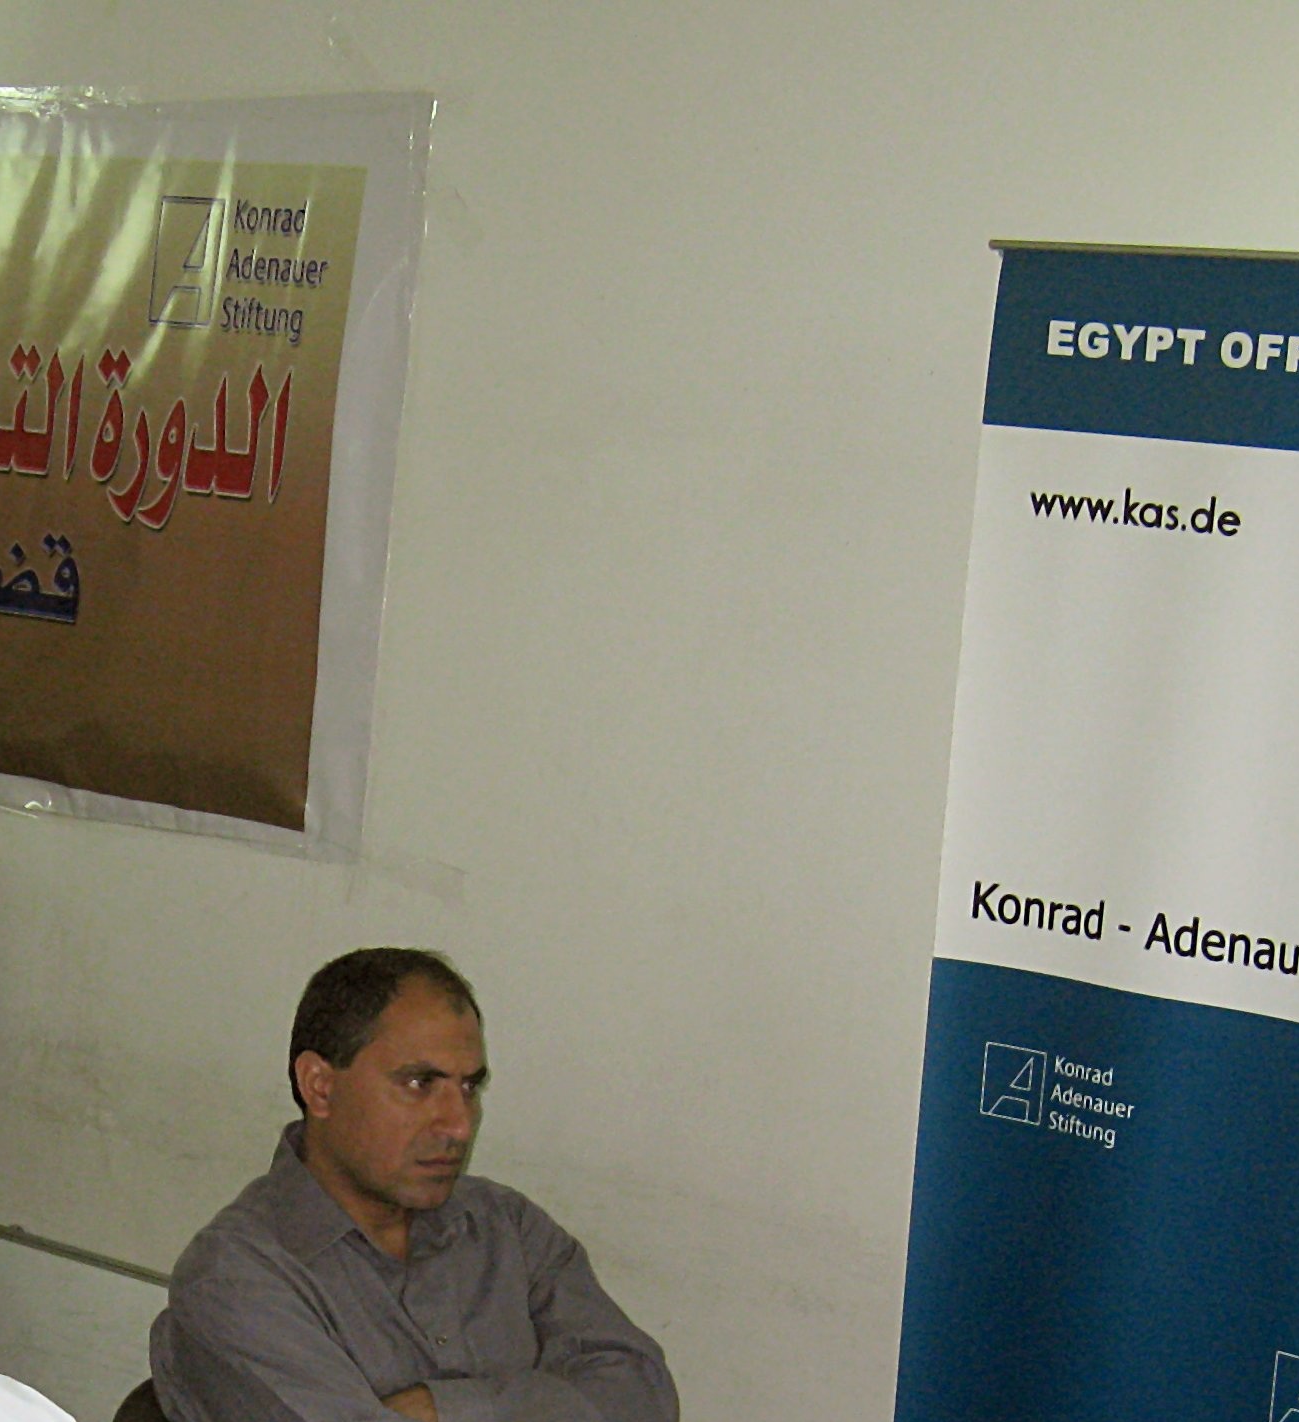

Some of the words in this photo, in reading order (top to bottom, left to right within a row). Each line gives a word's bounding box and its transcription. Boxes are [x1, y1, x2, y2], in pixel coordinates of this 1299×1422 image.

[234, 199, 308, 234] Konrad
[225, 247, 329, 286] Adenauer
[219, 295, 304, 344] Stiftung
[1047, 319, 1206, 366] EGYPT
[90, 345, 293, 528] الدورة
[1029, 487, 1243, 537] www.kas.de
[970, 880, 1106, 942] Konrad
[1054, 1054, 1114, 1087] Konrad
[1050, 1083, 1136, 1120] Adenauer
[1048, 1110, 1117, 1150] Stiftung
